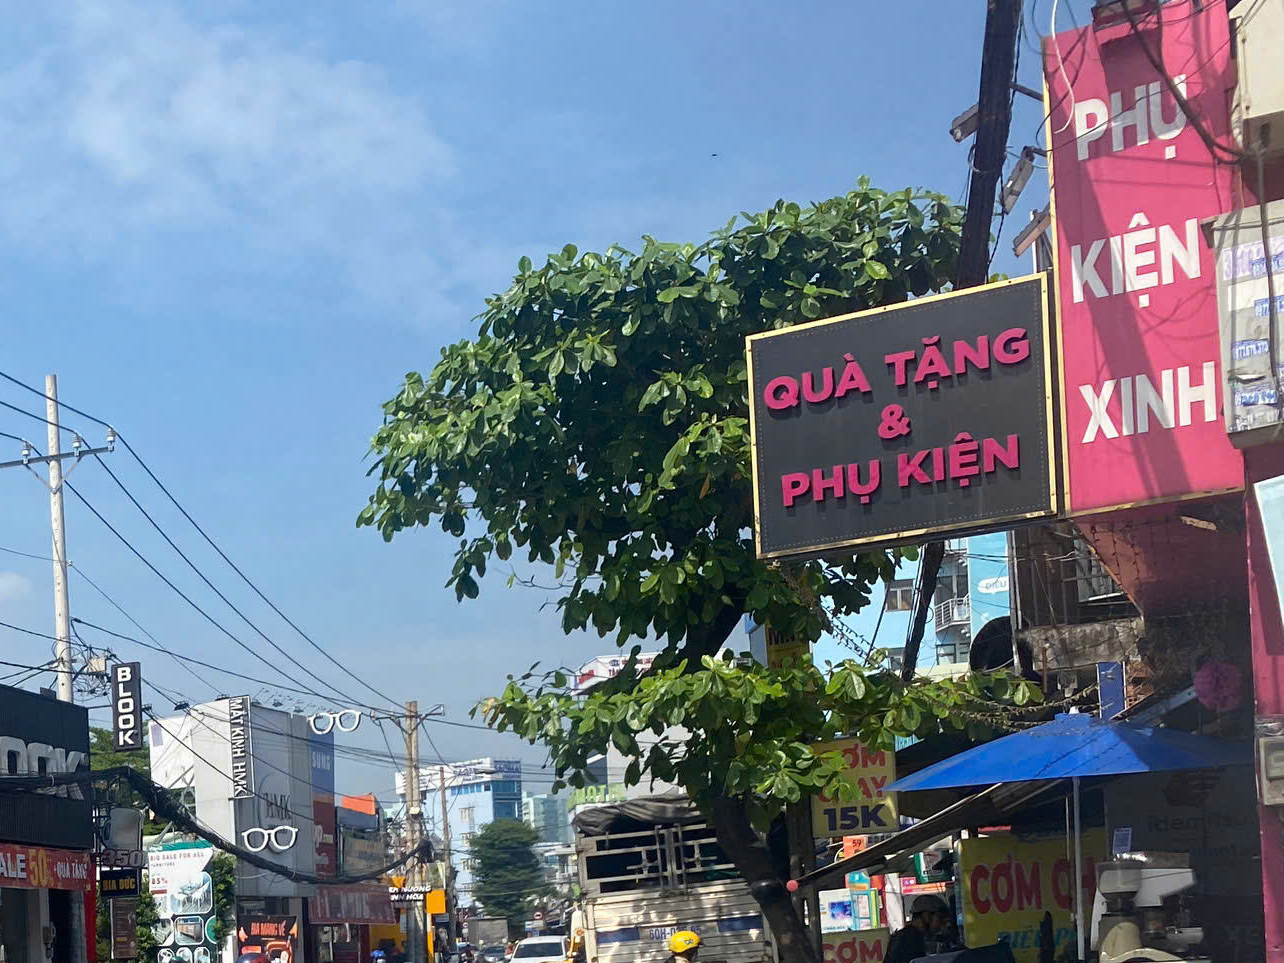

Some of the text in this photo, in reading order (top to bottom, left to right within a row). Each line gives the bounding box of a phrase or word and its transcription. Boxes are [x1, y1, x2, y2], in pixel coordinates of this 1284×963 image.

[1073, 73, 1187, 161] PHỤ
[1070, 211, 1201, 307] KIỆN
[764, 328, 1030, 410] QUÀ TẶNG
[1078, 360, 1217, 444] XINH
[877, 404, 911, 439] &
[781, 431, 1019, 507] PHỤ KIỆN
[117, 666, 135, 746] BLOOK
[842, 743, 885, 769] ƠM
[824, 804, 886, 831] 15K
[102, 850, 147, 868] 350
[970, 852, 1042, 914] CƠM
